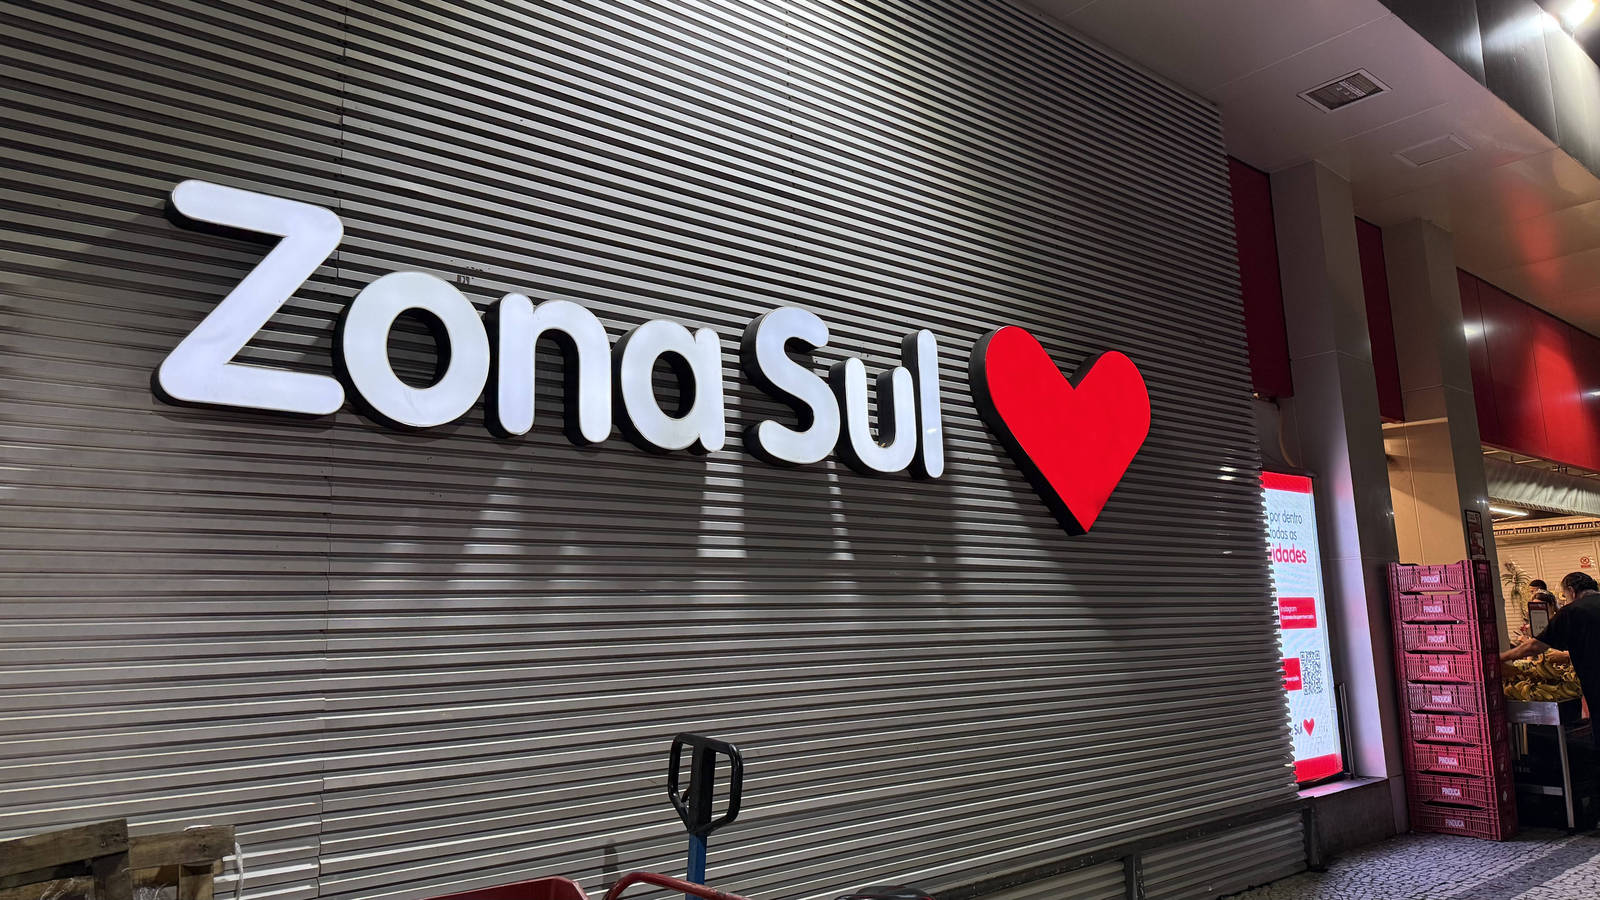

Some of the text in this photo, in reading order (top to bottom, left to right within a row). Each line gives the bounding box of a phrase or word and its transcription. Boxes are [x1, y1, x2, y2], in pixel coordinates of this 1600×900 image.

[158, 179, 945, 479] Zona Sul
[1282, 509, 1303, 525] dentro
[1289, 530, 1298, 541] as
[1268, 543, 1307, 564] idades
